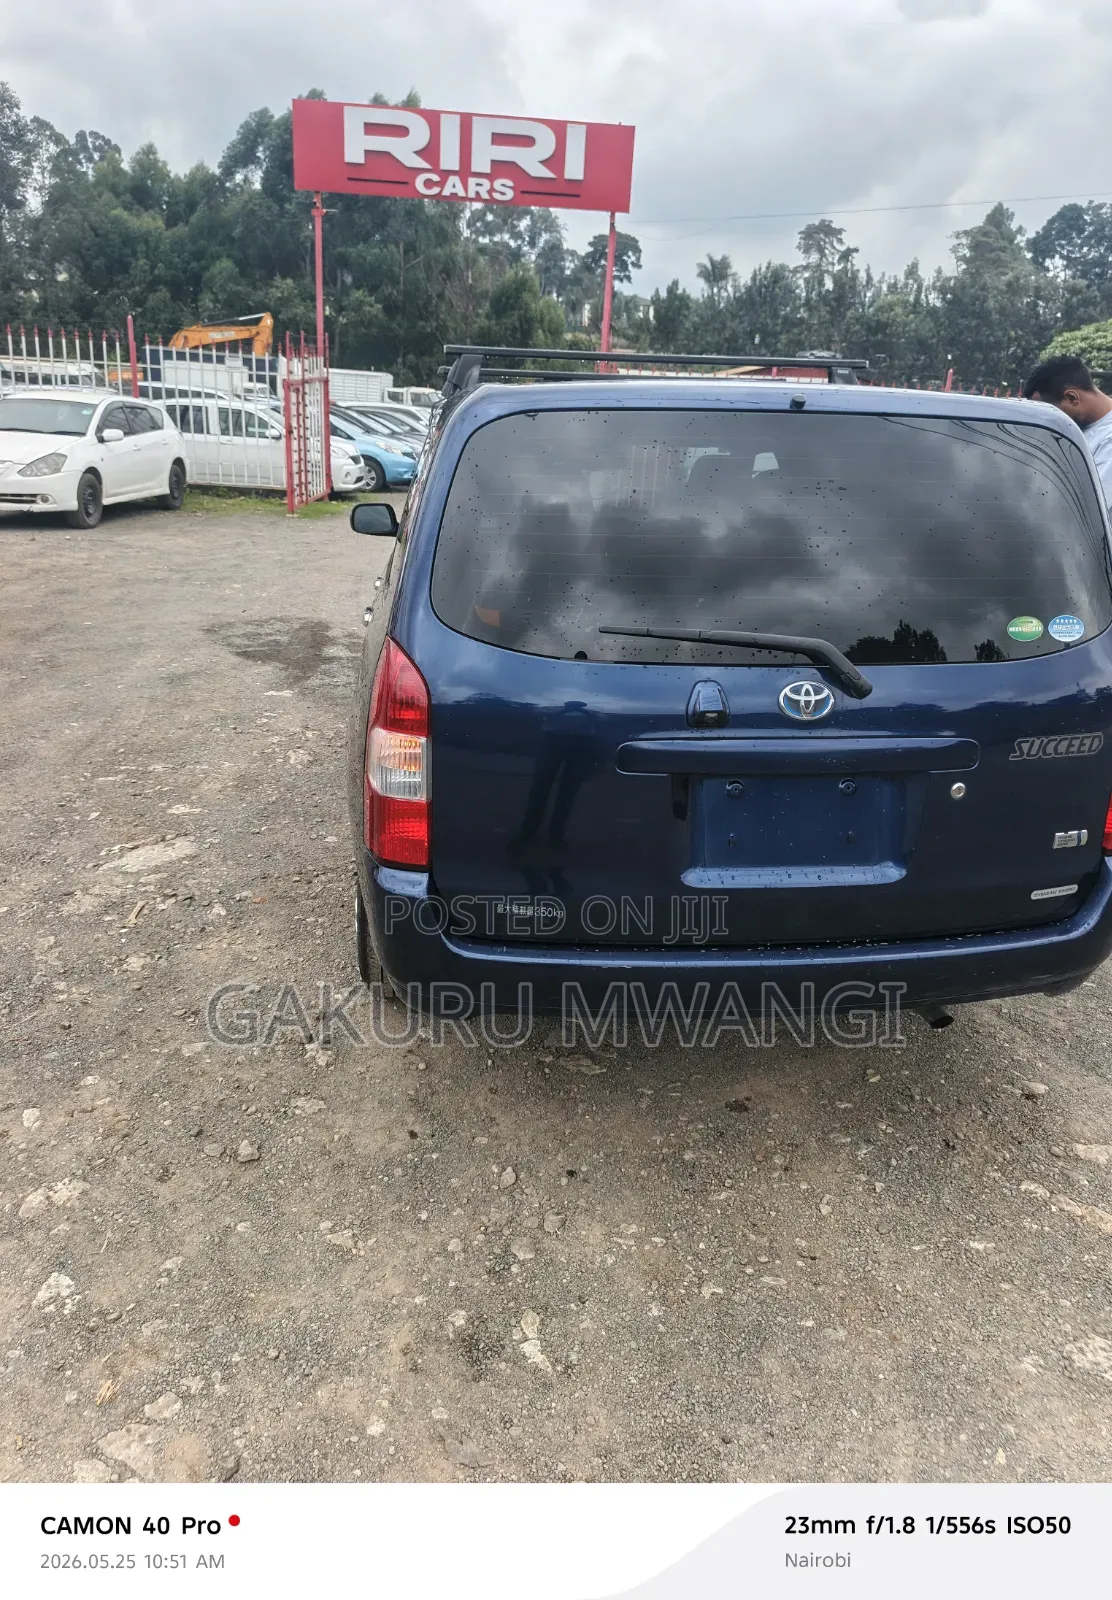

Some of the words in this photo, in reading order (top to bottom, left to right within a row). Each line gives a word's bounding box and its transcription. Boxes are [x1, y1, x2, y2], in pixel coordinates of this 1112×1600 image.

[344, 106, 587, 181] RIRI
[415, 173, 514, 201] CARS
[1009, 732, 1104, 761] SUCCEED
